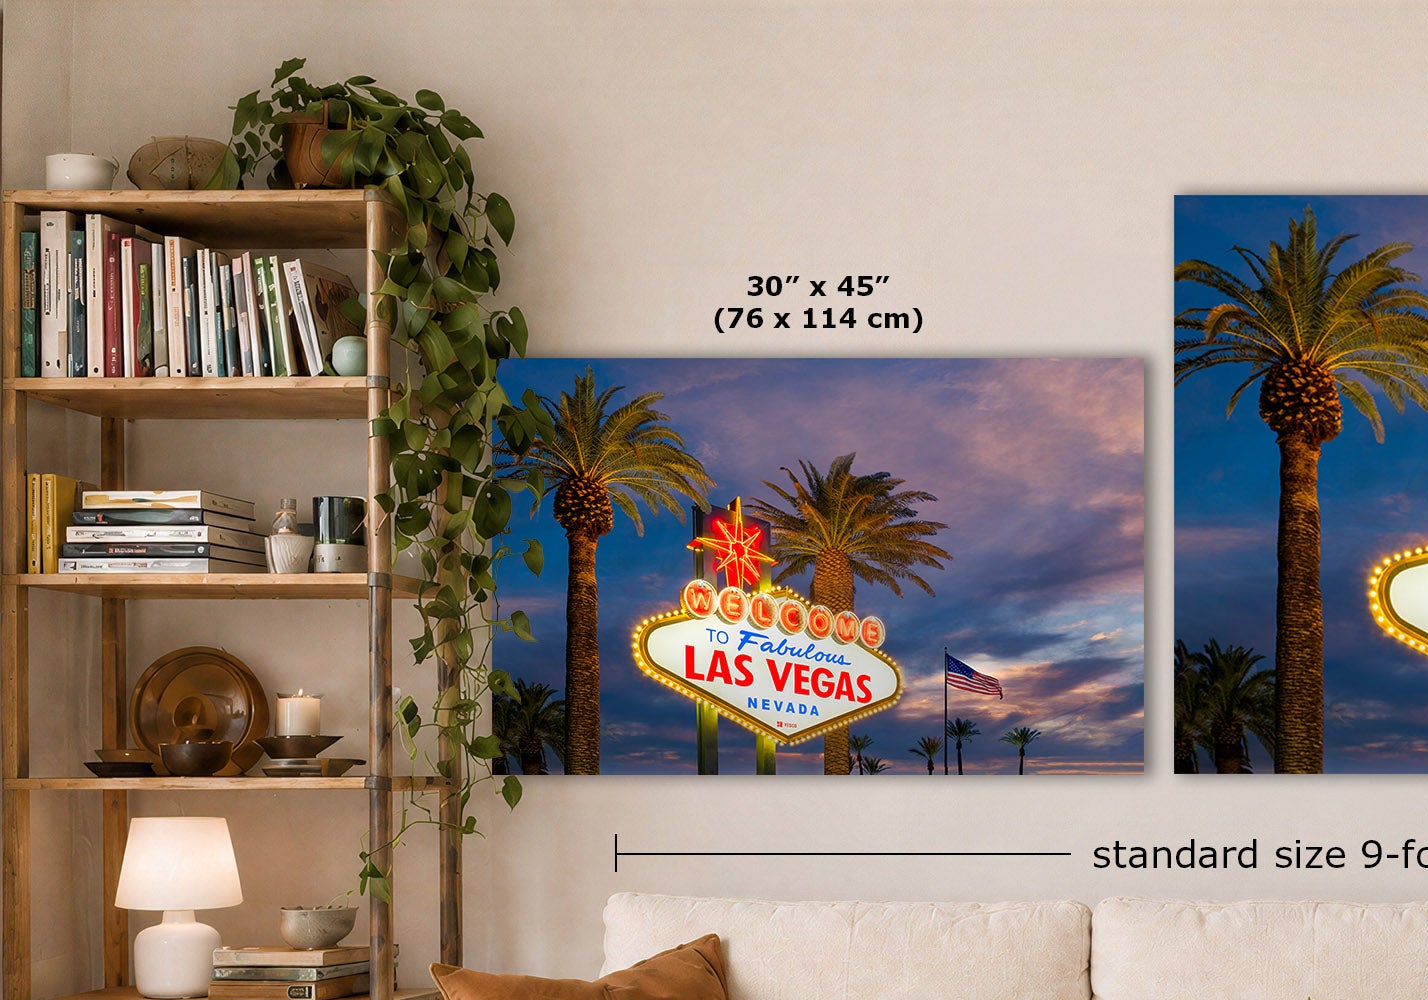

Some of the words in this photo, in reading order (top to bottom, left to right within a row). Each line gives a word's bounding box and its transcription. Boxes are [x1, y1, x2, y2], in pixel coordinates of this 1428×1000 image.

[688, 587, 880, 643] WELCOME
[705, 627, 730, 645] TO
[736, 629, 852, 667] Fabulous
[684, 644, 755, 688] LAS
[765, 657, 873, 705] VEGAS
[747, 696, 820, 717] NEVADA
